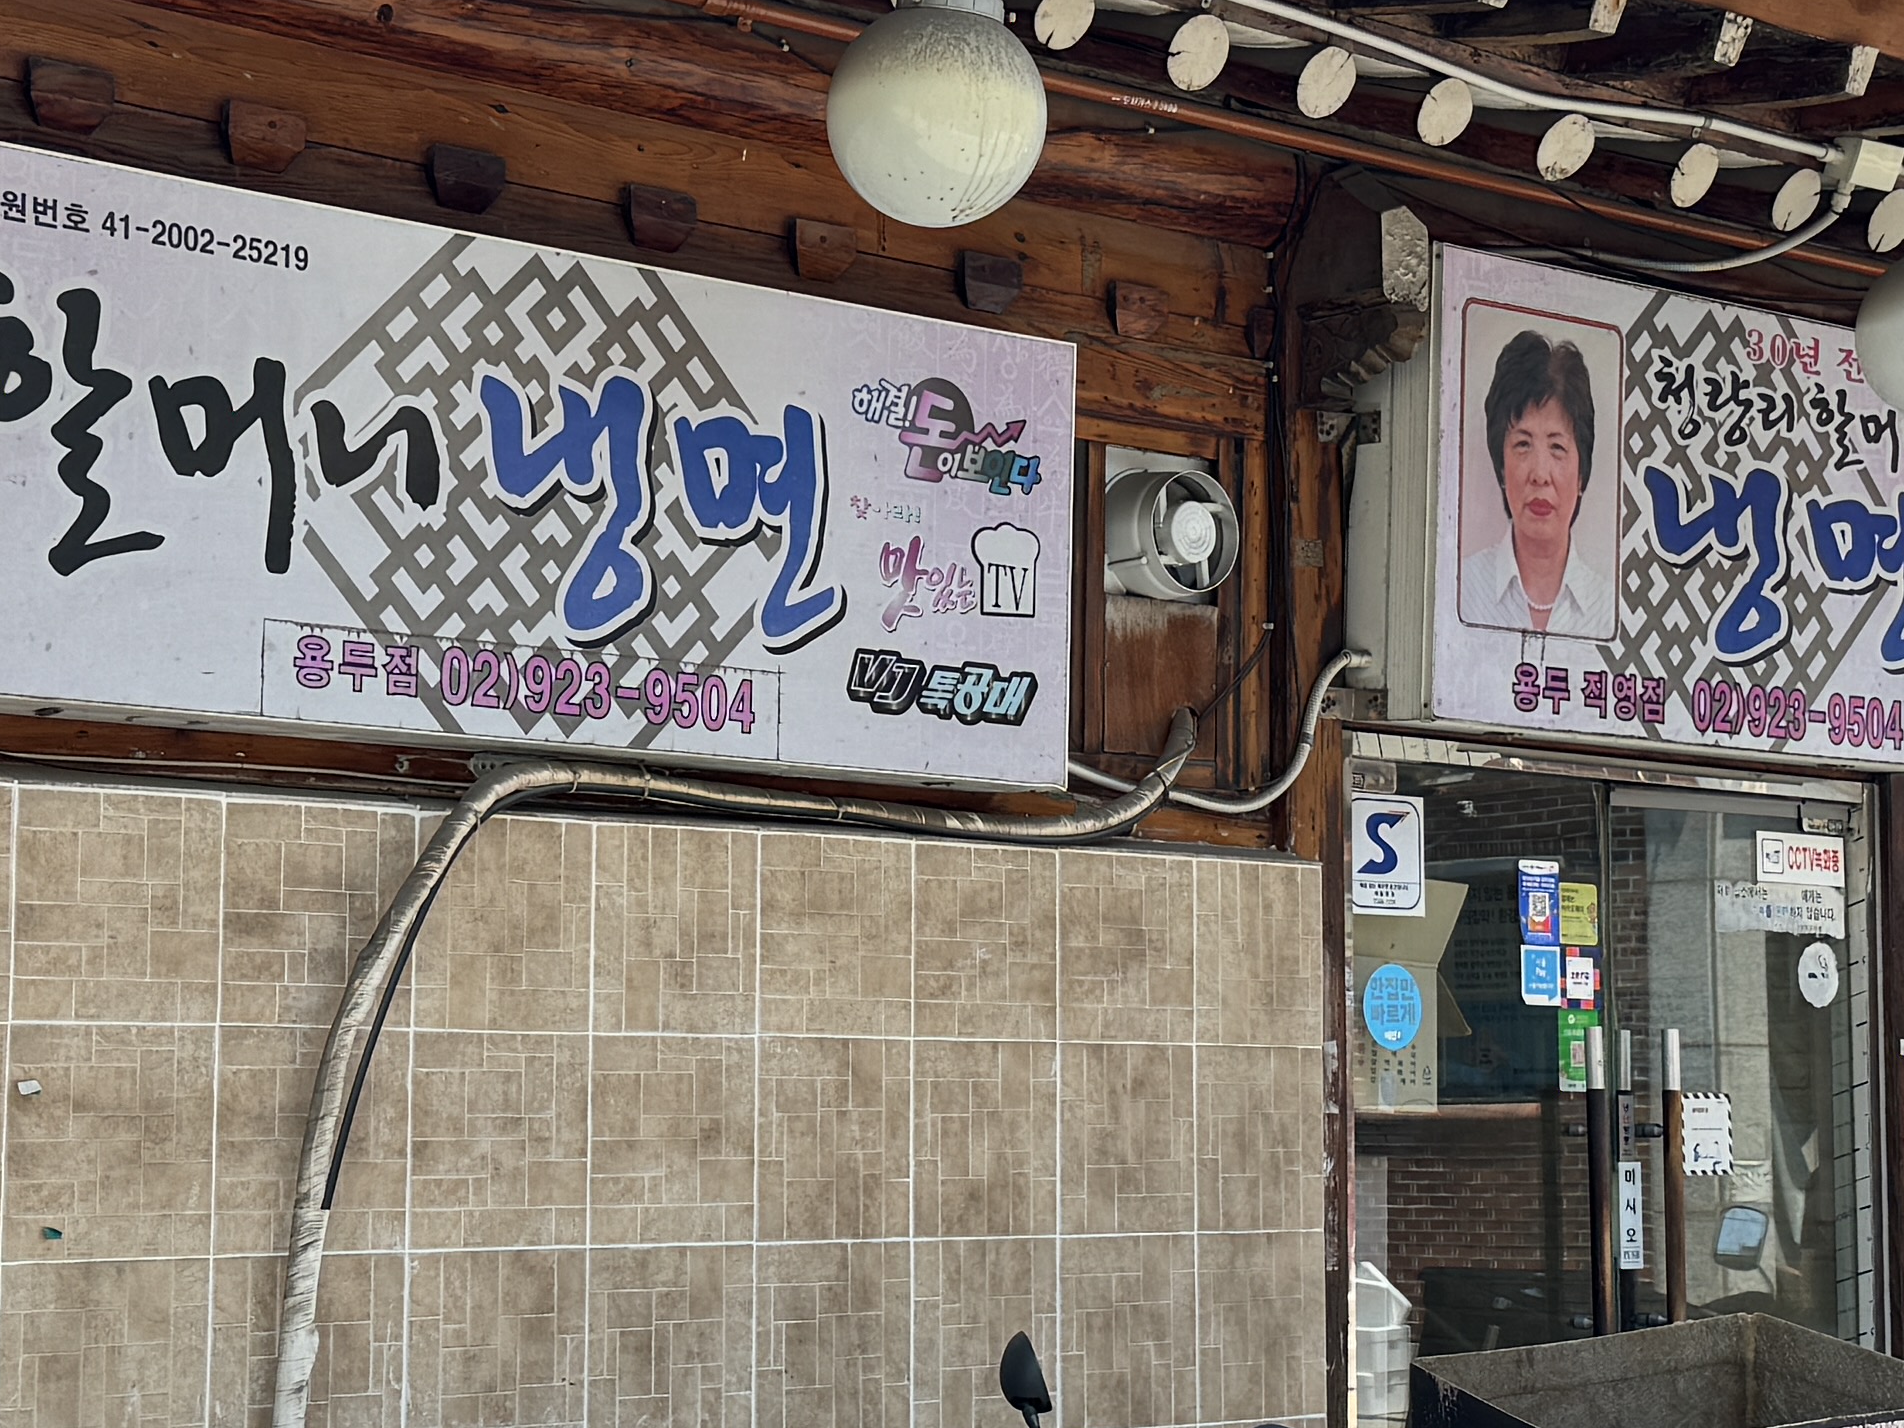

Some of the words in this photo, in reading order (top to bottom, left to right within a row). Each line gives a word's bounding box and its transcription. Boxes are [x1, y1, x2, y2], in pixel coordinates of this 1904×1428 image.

[101, 211, 310, 272] 41-2002-25219
[1747, 329, 1822, 376] 30년
[852, 378, 917, 428] 해결!
[479, 372, 841, 649] 냉면
[879, 535, 978, 633] 맛있는
[988, 562, 1029, 612] TV
[293, 634, 420, 698] 용두점
[440, 646, 756, 735] 02)923-9504
[1512, 663, 1570, 714] 용두
[1582, 670, 1666, 724] 직영점
[1692, 679, 1904, 750] 02)923-9504
[1624, 1167, 1638, 1243] 미시오
